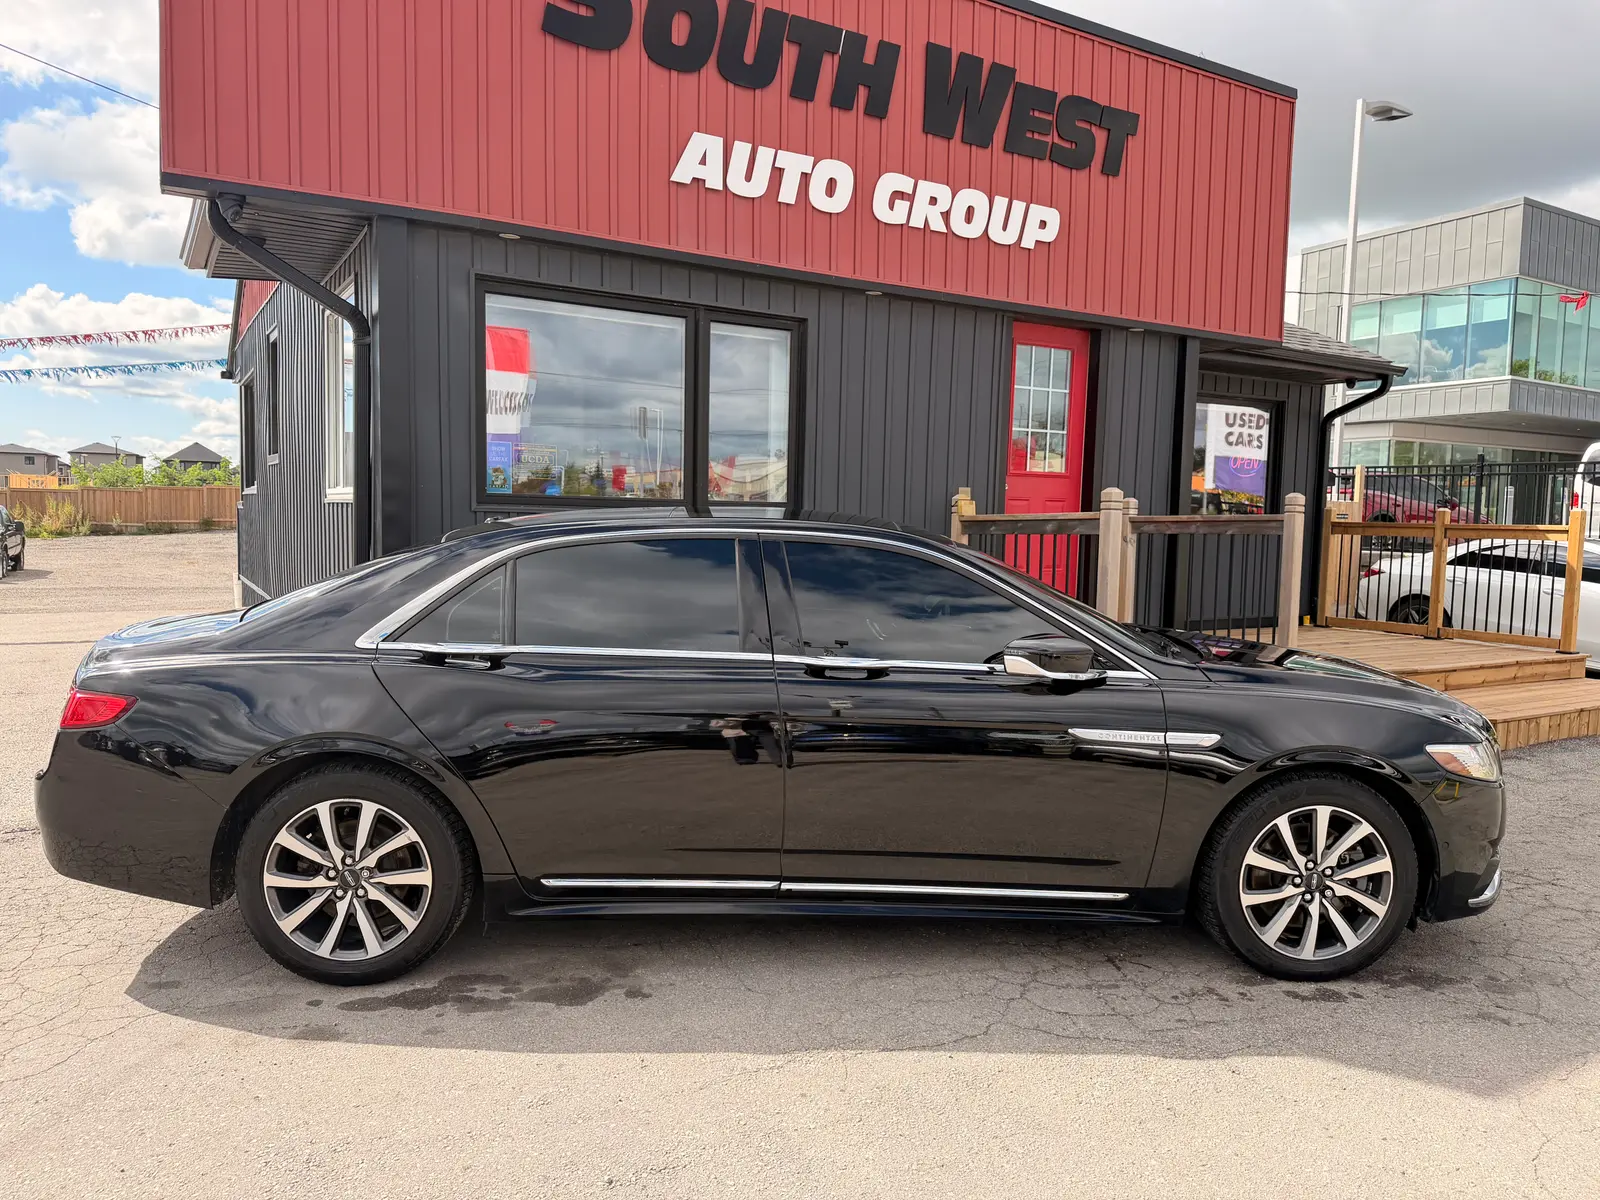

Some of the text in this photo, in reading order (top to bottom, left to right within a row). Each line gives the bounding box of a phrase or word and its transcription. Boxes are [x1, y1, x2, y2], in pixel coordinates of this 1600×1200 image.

[924, 41, 1140, 177] WEST
[669, 131, 1060, 250] AUTO GROUP
[1224, 412, 1266, 430] USED
[1224, 431, 1263, 450] CARS
[521, 455, 550, 463] UCDA
[1230, 456, 1260, 469] OPEN
[1097, 733, 1162, 742] CONTINENTAL
